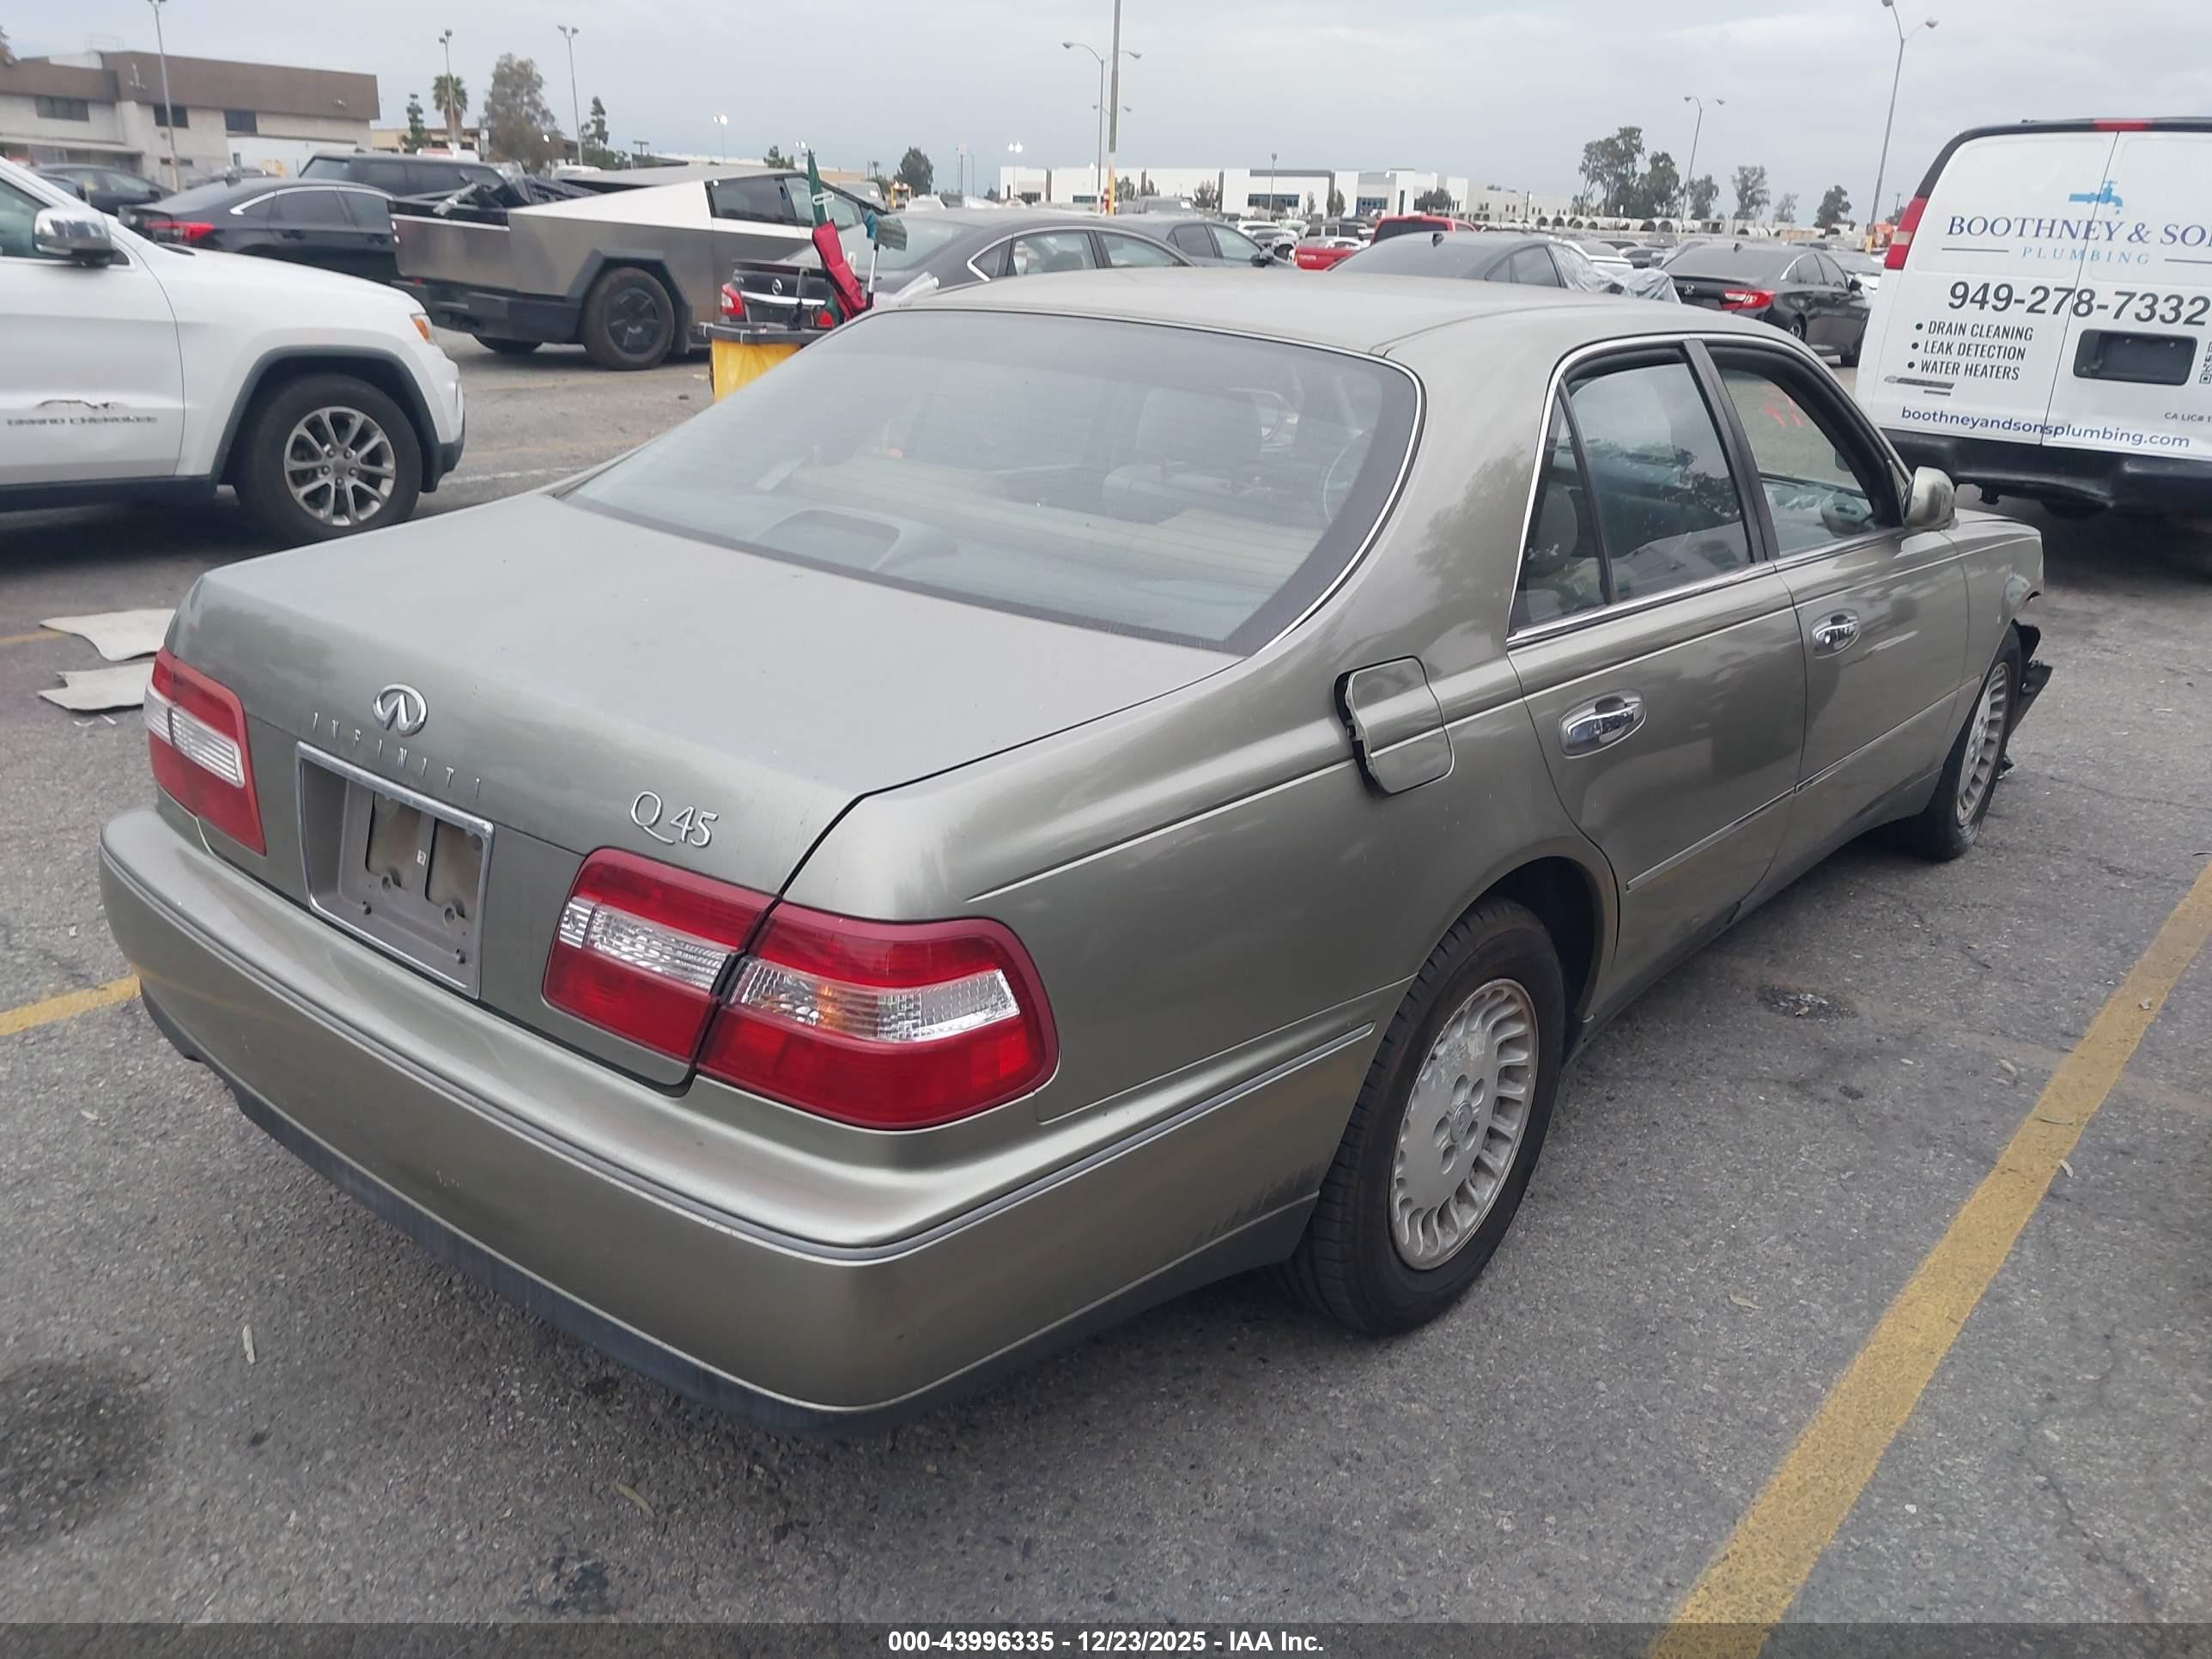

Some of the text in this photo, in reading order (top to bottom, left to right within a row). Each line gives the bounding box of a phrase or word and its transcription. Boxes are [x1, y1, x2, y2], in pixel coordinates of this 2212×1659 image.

[1946, 216, 2124, 241] BOOTHNEY
[2127, 222, 2151, 244] &
[2022, 246, 2150, 265] PLUMBING
[1948, 281, 2211, 326] 949-278-7332
[1928, 320, 2034, 341] DRAIN CLEANING
[1923, 340, 2027, 361] LEAK DETECTION
[1920, 359, 2021, 380] WATER HEATERS
[1901, 406, 2190, 448] boothneyandsonsplumbing.com
[312, 712, 483, 798] INFINITI
